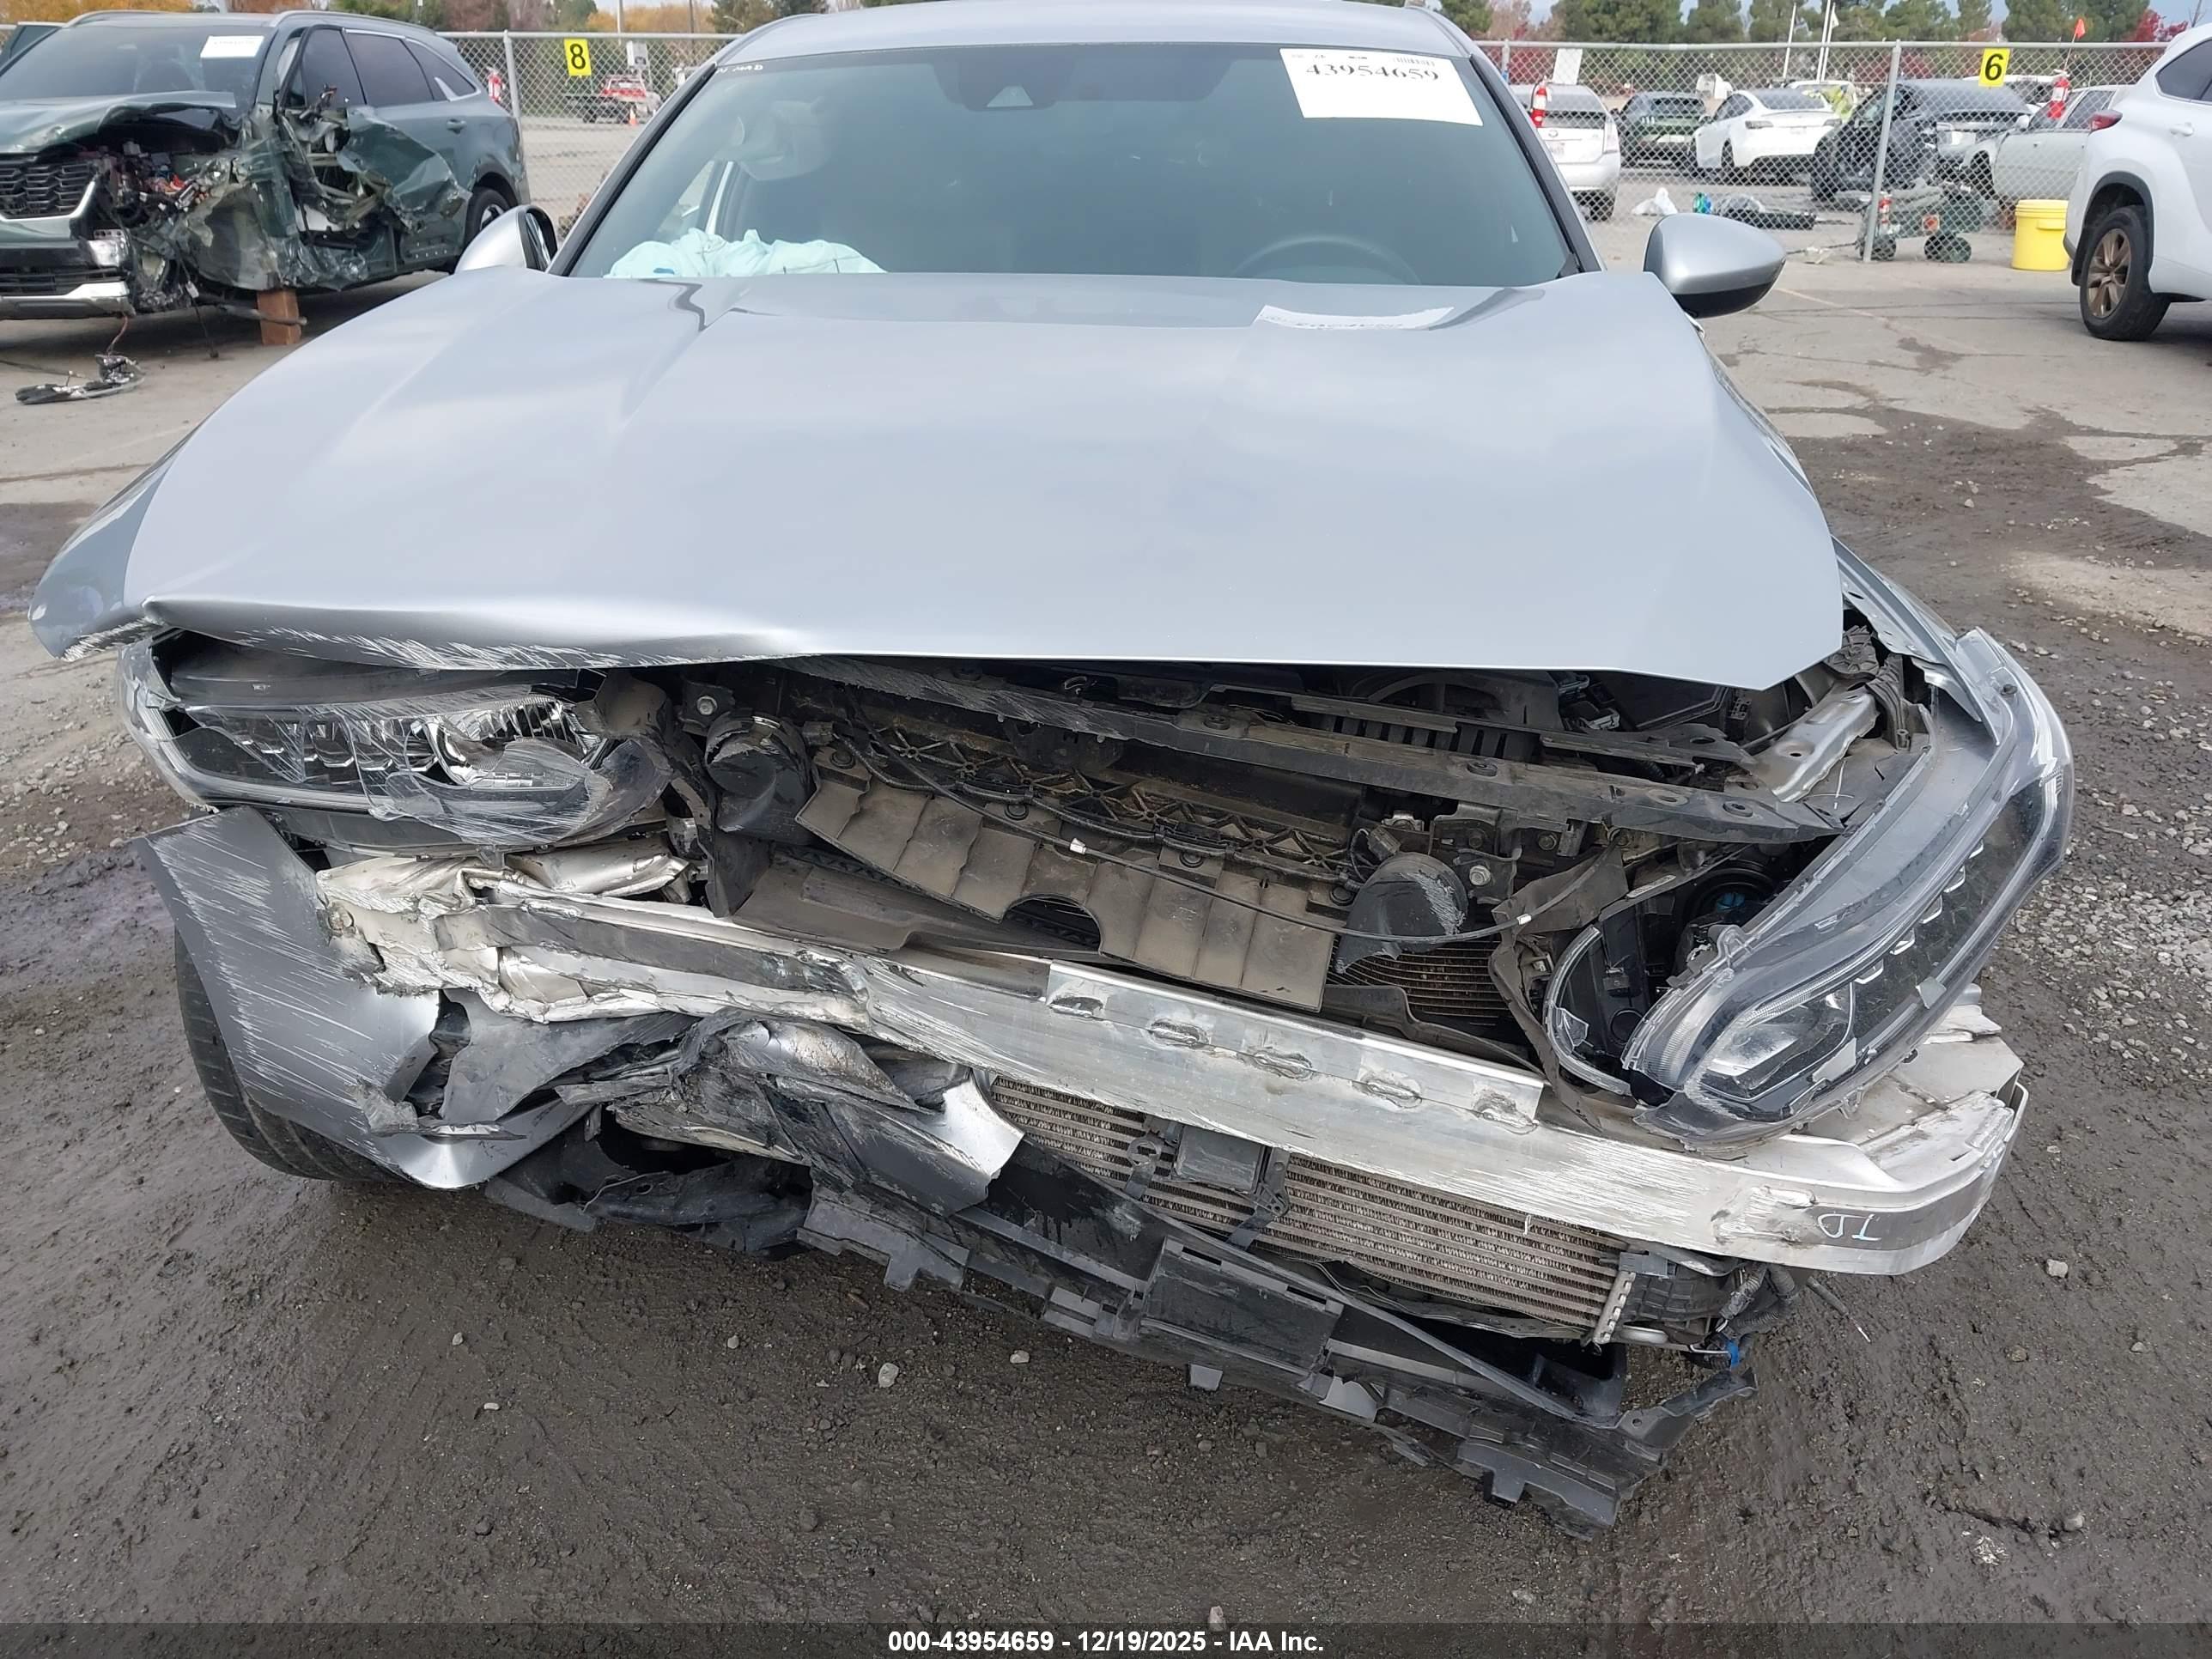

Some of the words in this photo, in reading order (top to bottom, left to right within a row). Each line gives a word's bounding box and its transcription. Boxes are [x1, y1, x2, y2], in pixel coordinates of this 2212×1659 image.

[569, 43, 586, 70] 8
[1984, 53, 2004, 82] 6
[1305, 63, 1439, 82] 43954659
